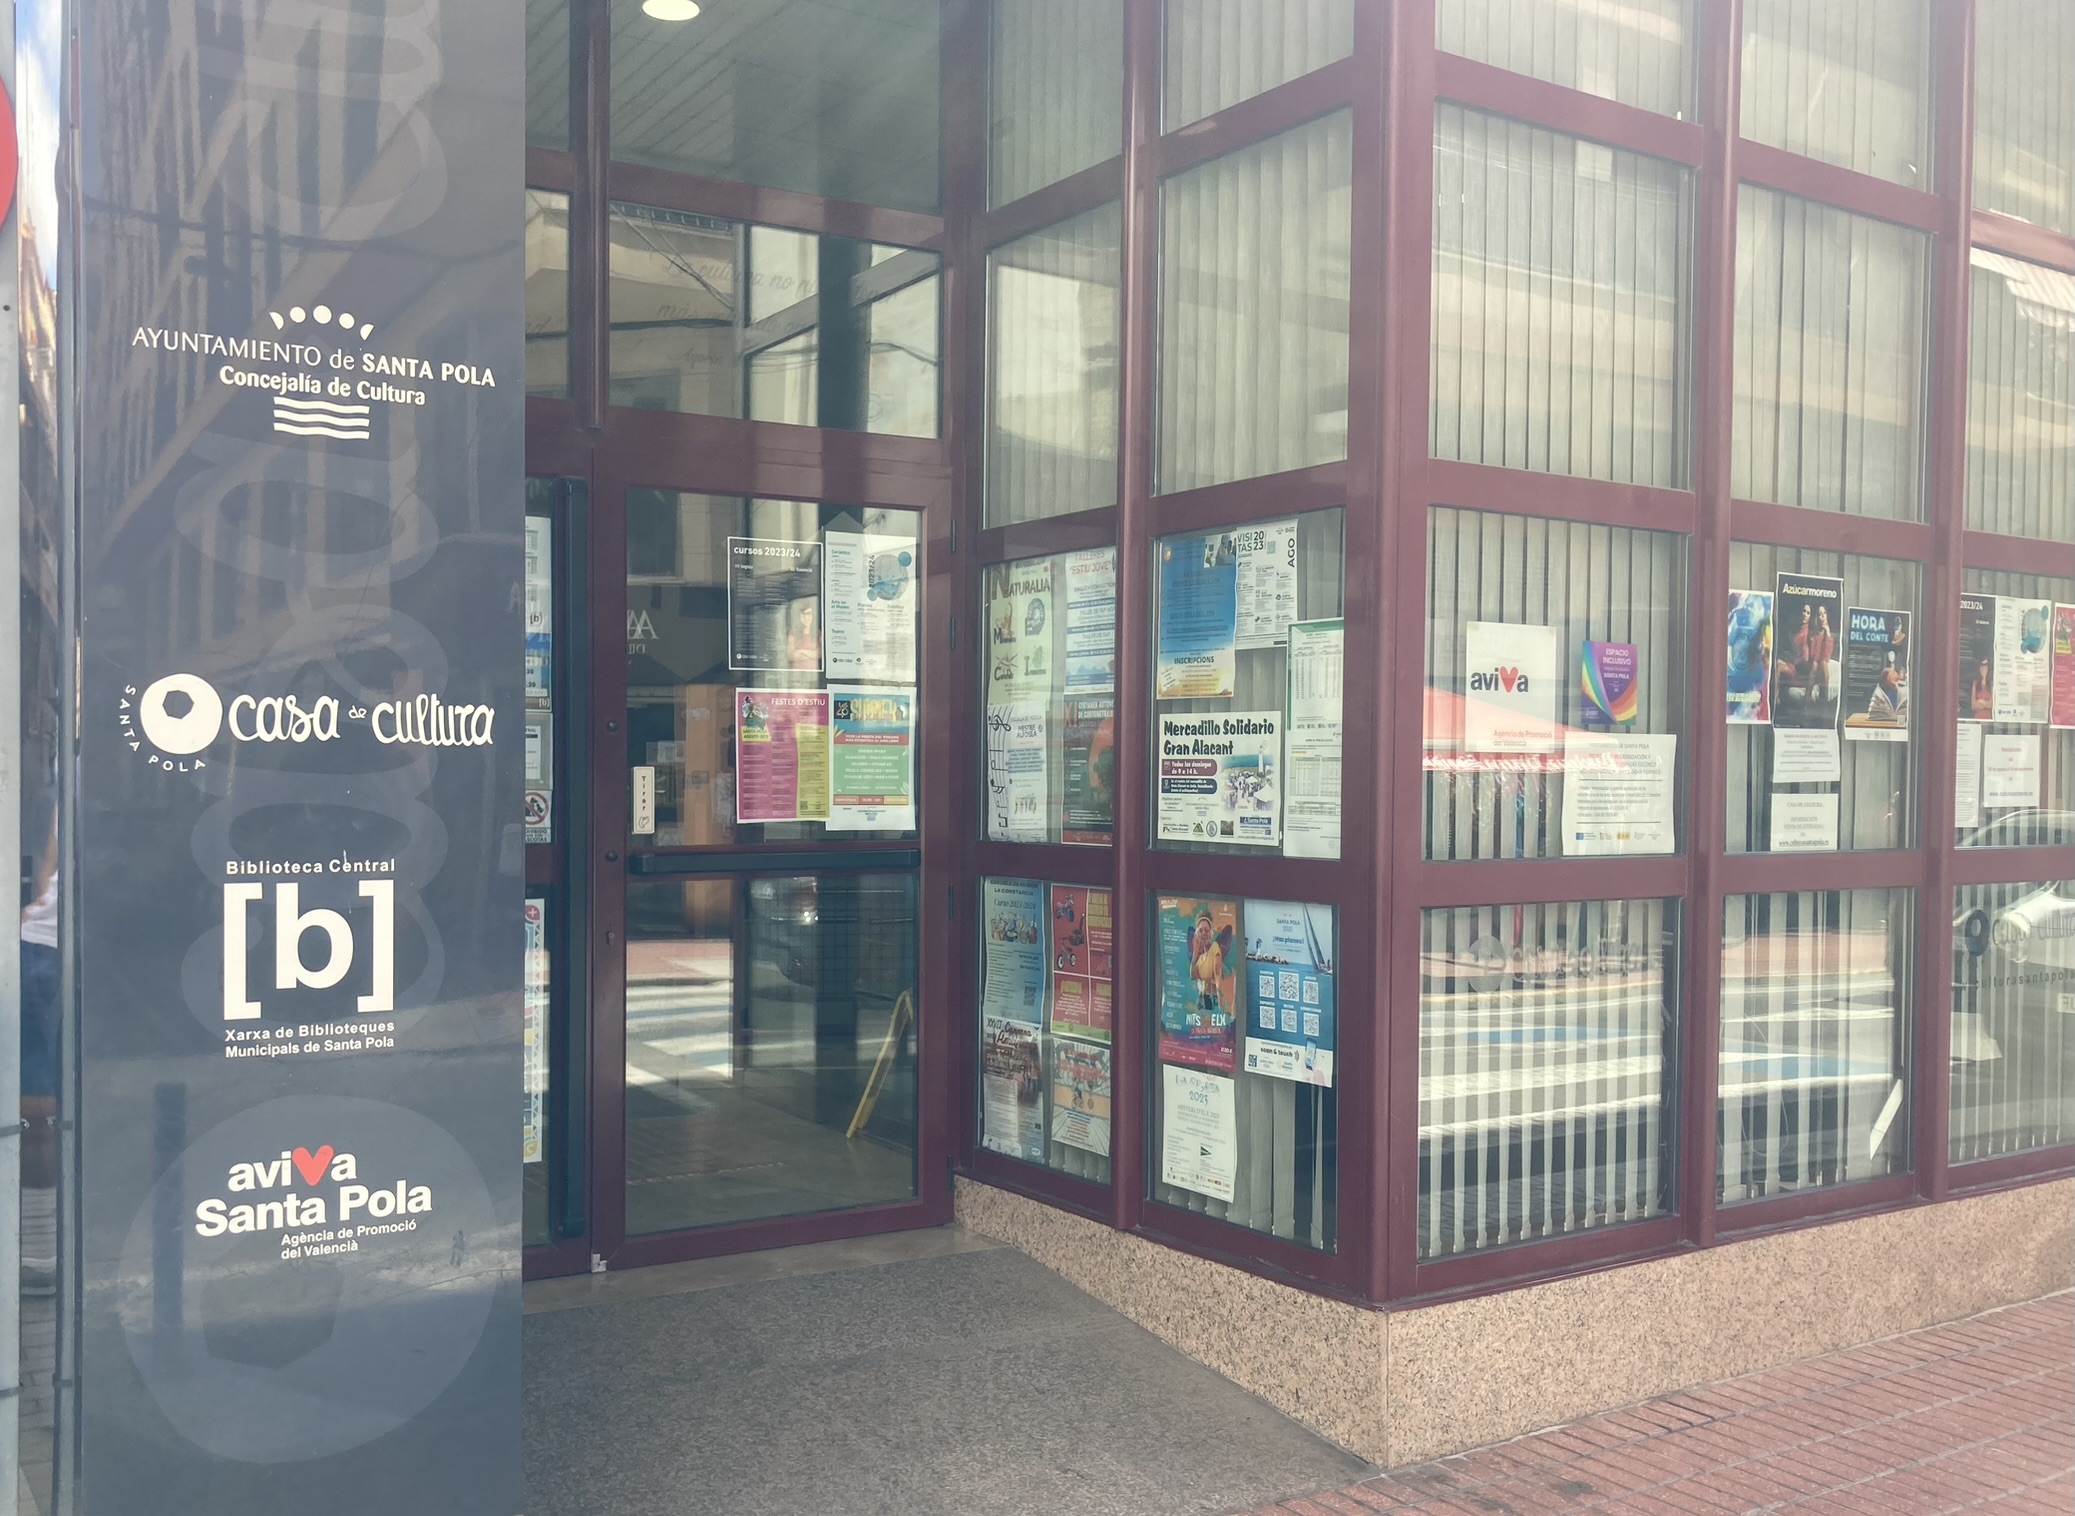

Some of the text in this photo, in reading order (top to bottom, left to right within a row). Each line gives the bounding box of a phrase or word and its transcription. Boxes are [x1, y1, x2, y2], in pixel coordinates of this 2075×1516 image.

[132, 327, 496, 388] AYUNTAMIENTO de SANTA POLA
[219, 366, 426, 406] Concejalía de Cultura
[734, 547, 801, 558] cursos 2023/24
[1287, 538, 1296, 568] AGO
[1782, 583, 1838, 598] Azúcarmoreno
[1851, 614, 1886, 631] HORA
[1850, 631, 1889, 643] DEL CONTE
[771, 698, 796, 706] FESTES
[118, 684, 207, 773] SANTA POLA
[228, 694, 342, 742] casa
[371, 693, 496, 747] cultura
[1164, 719, 1275, 737] Mercadillo Solidario
[1164, 739, 1234, 755] Gran Alacant
[226, 857, 396, 875] Biblioteca Central
[225, 1020, 395, 1041] Xarxa de Biblioteques
[225, 1036, 395, 1058] Municipals de Santa Pola
[195, 1180, 432, 1237] Santa Pola
[281, 1219, 417, 1247] Agència de Promoció
[281, 1240, 358, 1259] del Valencià
